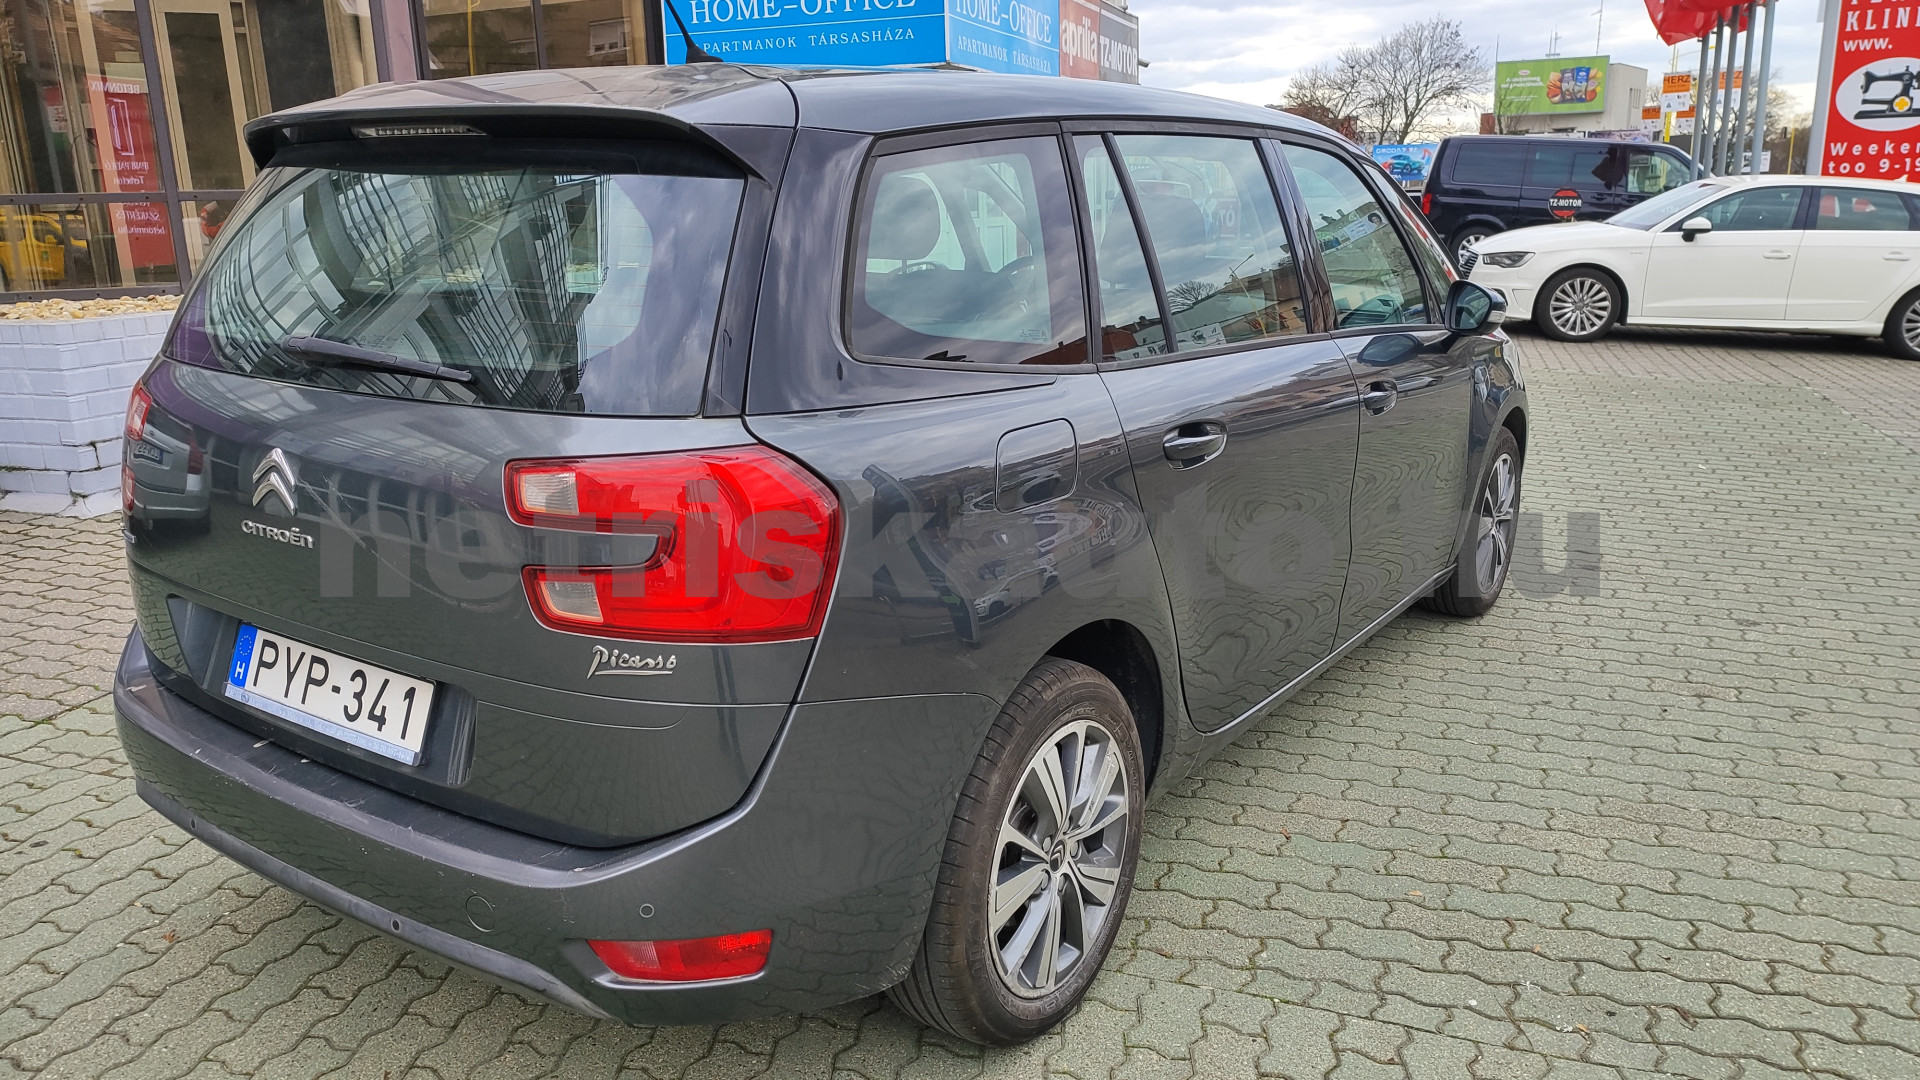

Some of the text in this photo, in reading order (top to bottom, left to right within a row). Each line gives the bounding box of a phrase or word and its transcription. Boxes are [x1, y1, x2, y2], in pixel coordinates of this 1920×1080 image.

[696, 27, 915, 53] PARTMANOK TÁRSASHÁZA
[957, 34, 1008, 63] APARTMANOK
[1061, 16, 1098, 66] aprilia
[1843, 37, 1893, 53] www.
[1100, 35, 1138, 76] TZ-MOTOR
[1663, 74, 1691, 84] HERZ
[1827, 161, 1866, 175] too
[1549, 197, 1583, 208] TZ-MOTOR
[234, 660, 246, 680] H
[586, 645, 677, 679] Picasso
[252, 638, 417, 741] PYP-341
